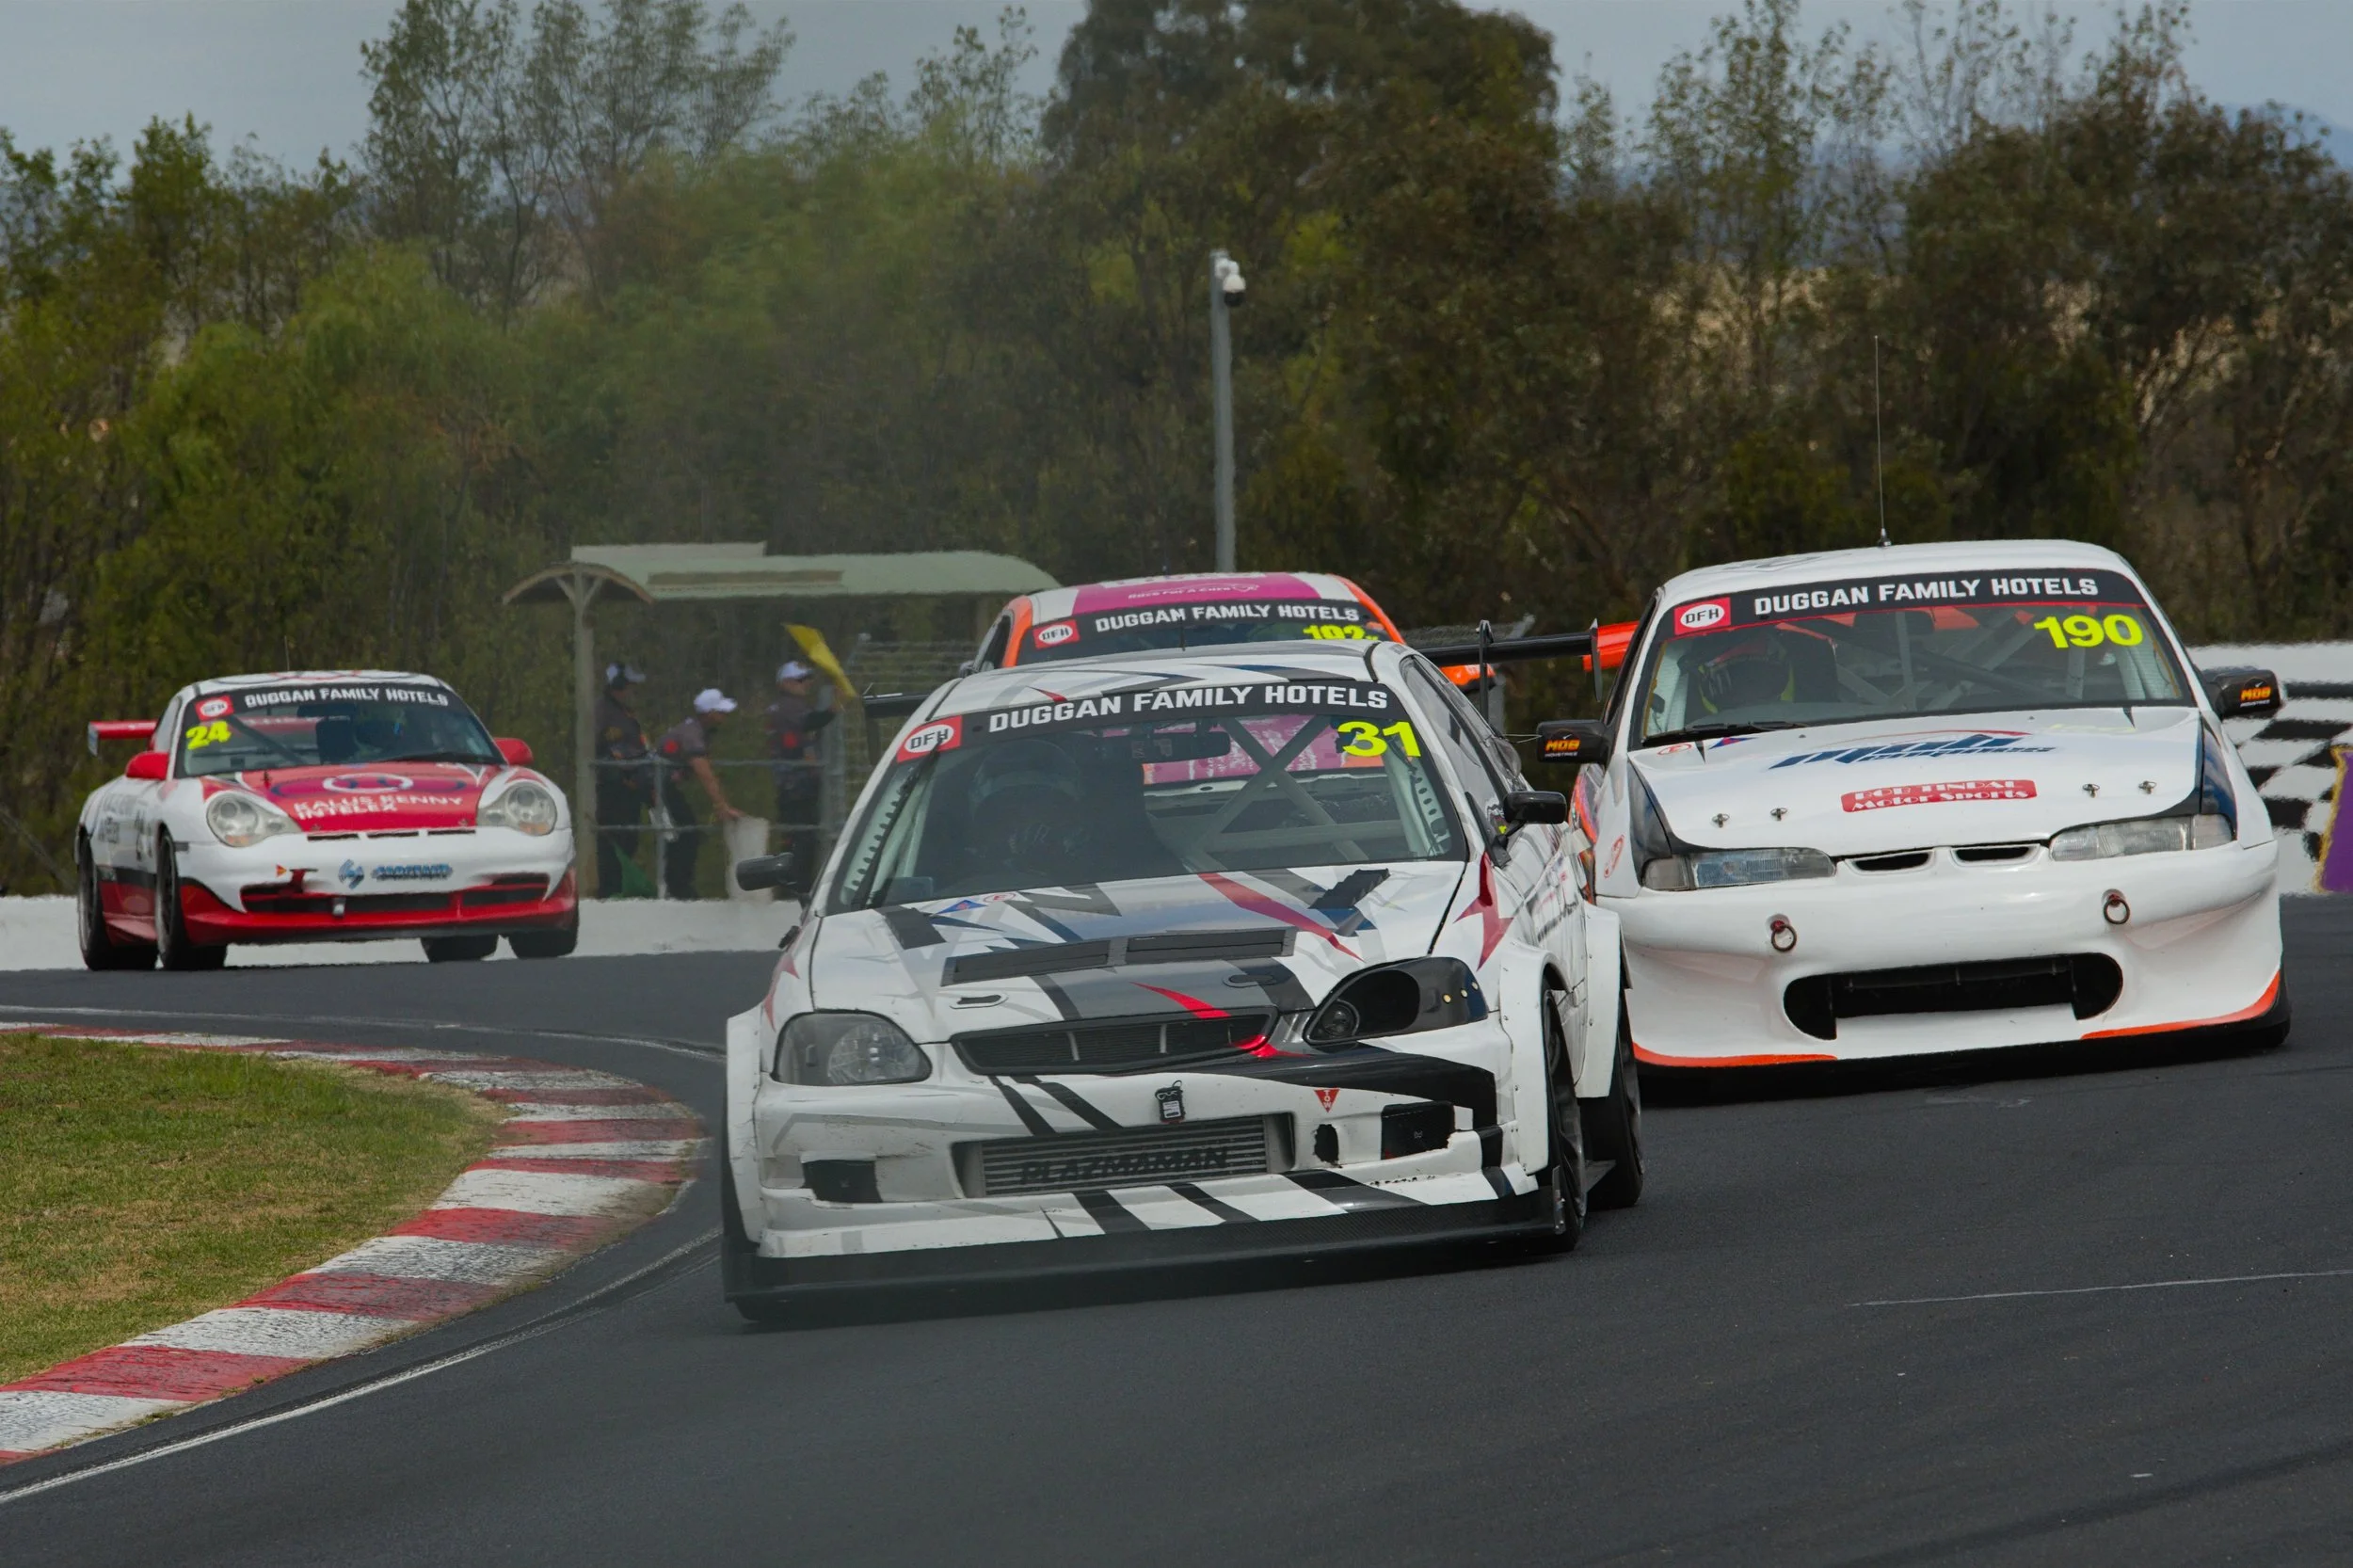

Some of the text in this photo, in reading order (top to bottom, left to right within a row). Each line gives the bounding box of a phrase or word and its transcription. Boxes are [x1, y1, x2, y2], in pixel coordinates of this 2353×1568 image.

[1753, 577, 2099, 616] DUGGAN FAMILY HOTELS
[1096, 604, 1360, 632] DUGGAN FAMILY HOTELS
[1685, 607, 1721, 623] DFH
[1041, 627, 1071, 641] DFH
[2033, 614, 2144, 648] 190
[245, 687, 449, 708] DUGGAN FAMILY HOTELS
[989, 685, 1388, 733] DUGGAN FAMILY HOTELS
[185, 721, 232, 750] 24
[909, 728, 950, 751] DFH
[1337, 721, 1421, 758] 31
[379, 794, 463, 806] KENNY
[1852, 790, 2028, 811] Motor Sports
[1854, 780, 2024, 800] ROB TINDAL
[1322, 1089, 1331, 1109] TOW
[1021, 1146, 1227, 1185] PLAZMAMAN
